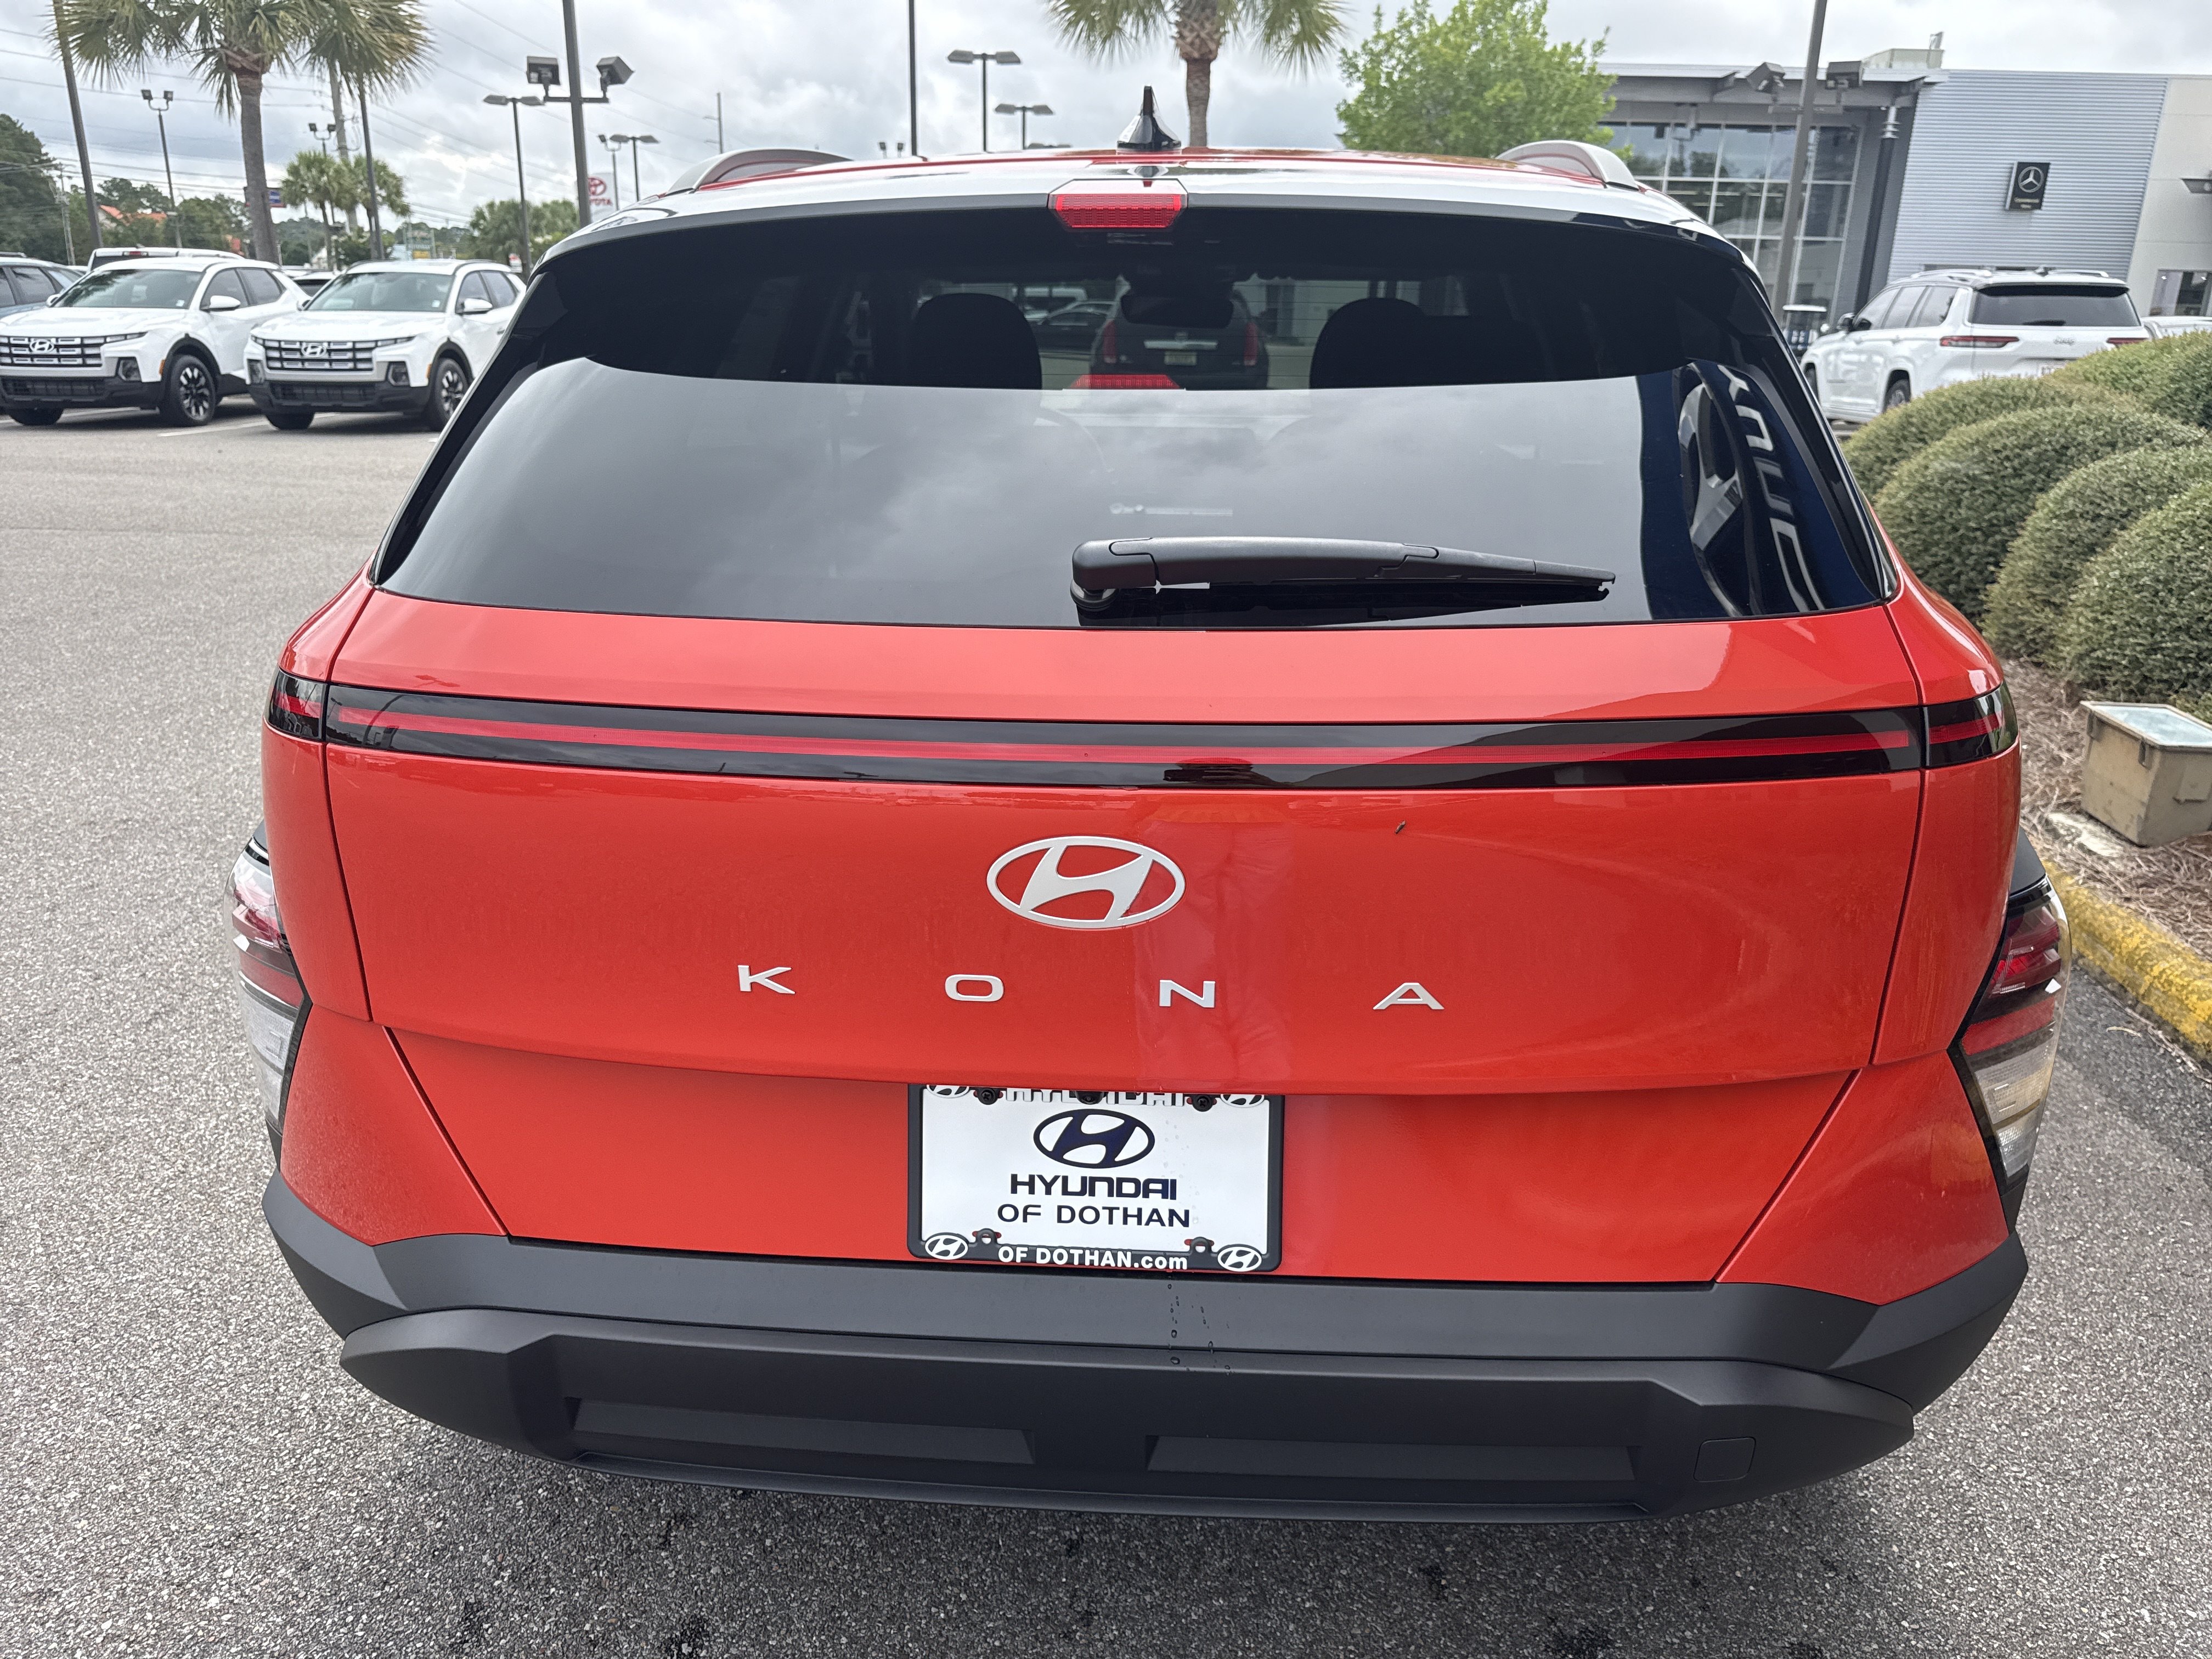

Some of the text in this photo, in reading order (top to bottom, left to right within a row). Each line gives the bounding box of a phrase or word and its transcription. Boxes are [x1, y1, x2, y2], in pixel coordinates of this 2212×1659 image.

[737, 965, 1445, 1010] KONA
[1011, 1173, 1177, 1200] HYUNDAI
[997, 1204, 1189, 1227] OF DOTHAN
[998, 1246, 1188, 1269] OF DOTHAN.com
